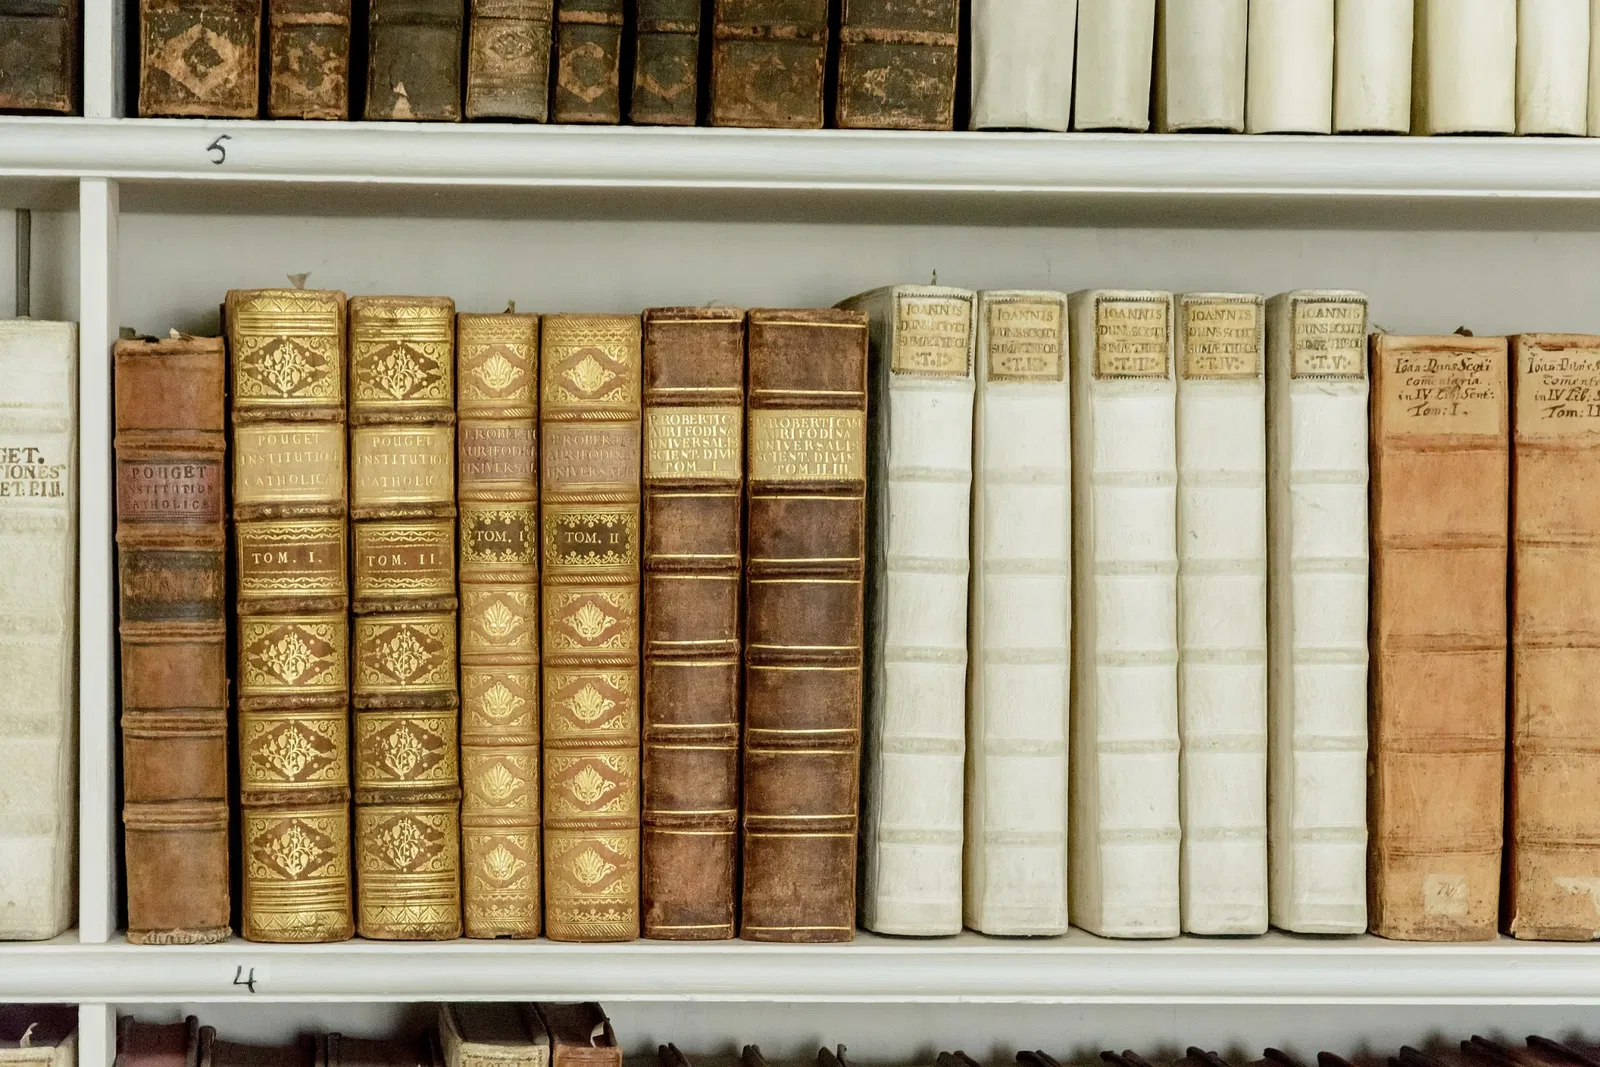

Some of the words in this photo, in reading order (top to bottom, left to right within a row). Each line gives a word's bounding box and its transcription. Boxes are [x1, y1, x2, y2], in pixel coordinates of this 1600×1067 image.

[206, 134, 232, 165] 5
[131, 466, 206, 480] POUGET
[475, 530, 513, 543] TOM.
[518, 531, 525, 542] I
[563, 532, 602, 544] TOM.
[608, 533, 619, 544] II
[251, 552, 297, 564] TOM.
[366, 555, 407, 566] TOM.
[234, 966, 257, 993] 4
